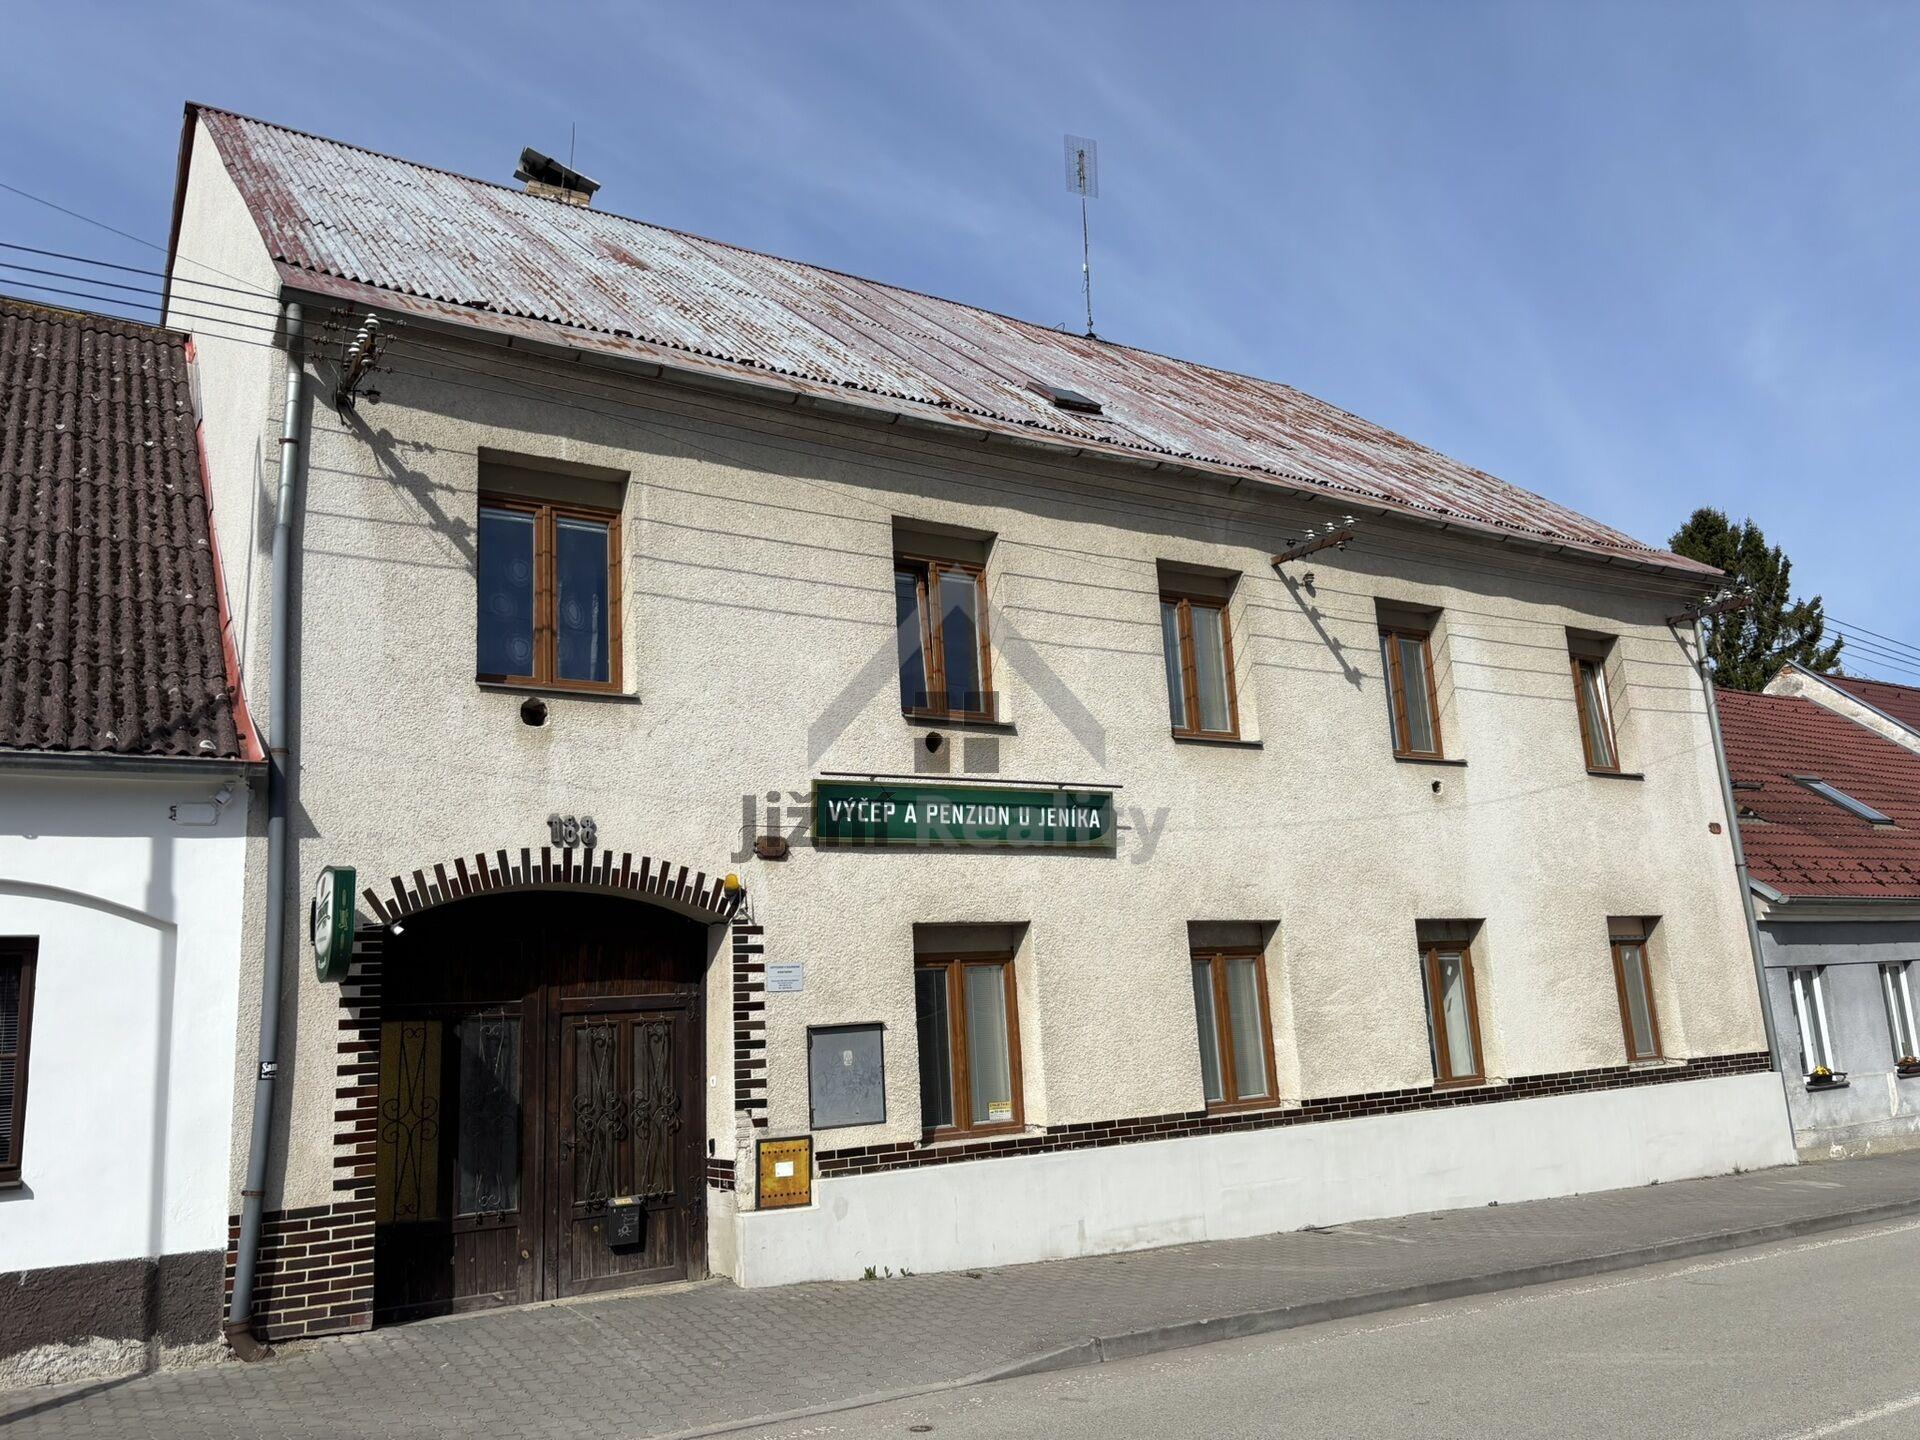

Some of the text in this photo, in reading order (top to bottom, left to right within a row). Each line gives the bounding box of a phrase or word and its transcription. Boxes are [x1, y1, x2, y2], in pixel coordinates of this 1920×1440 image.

[828, 797, 1101, 829] VÝČEP A PENZION U JENÍKA
[547, 813, 597, 847] 188
